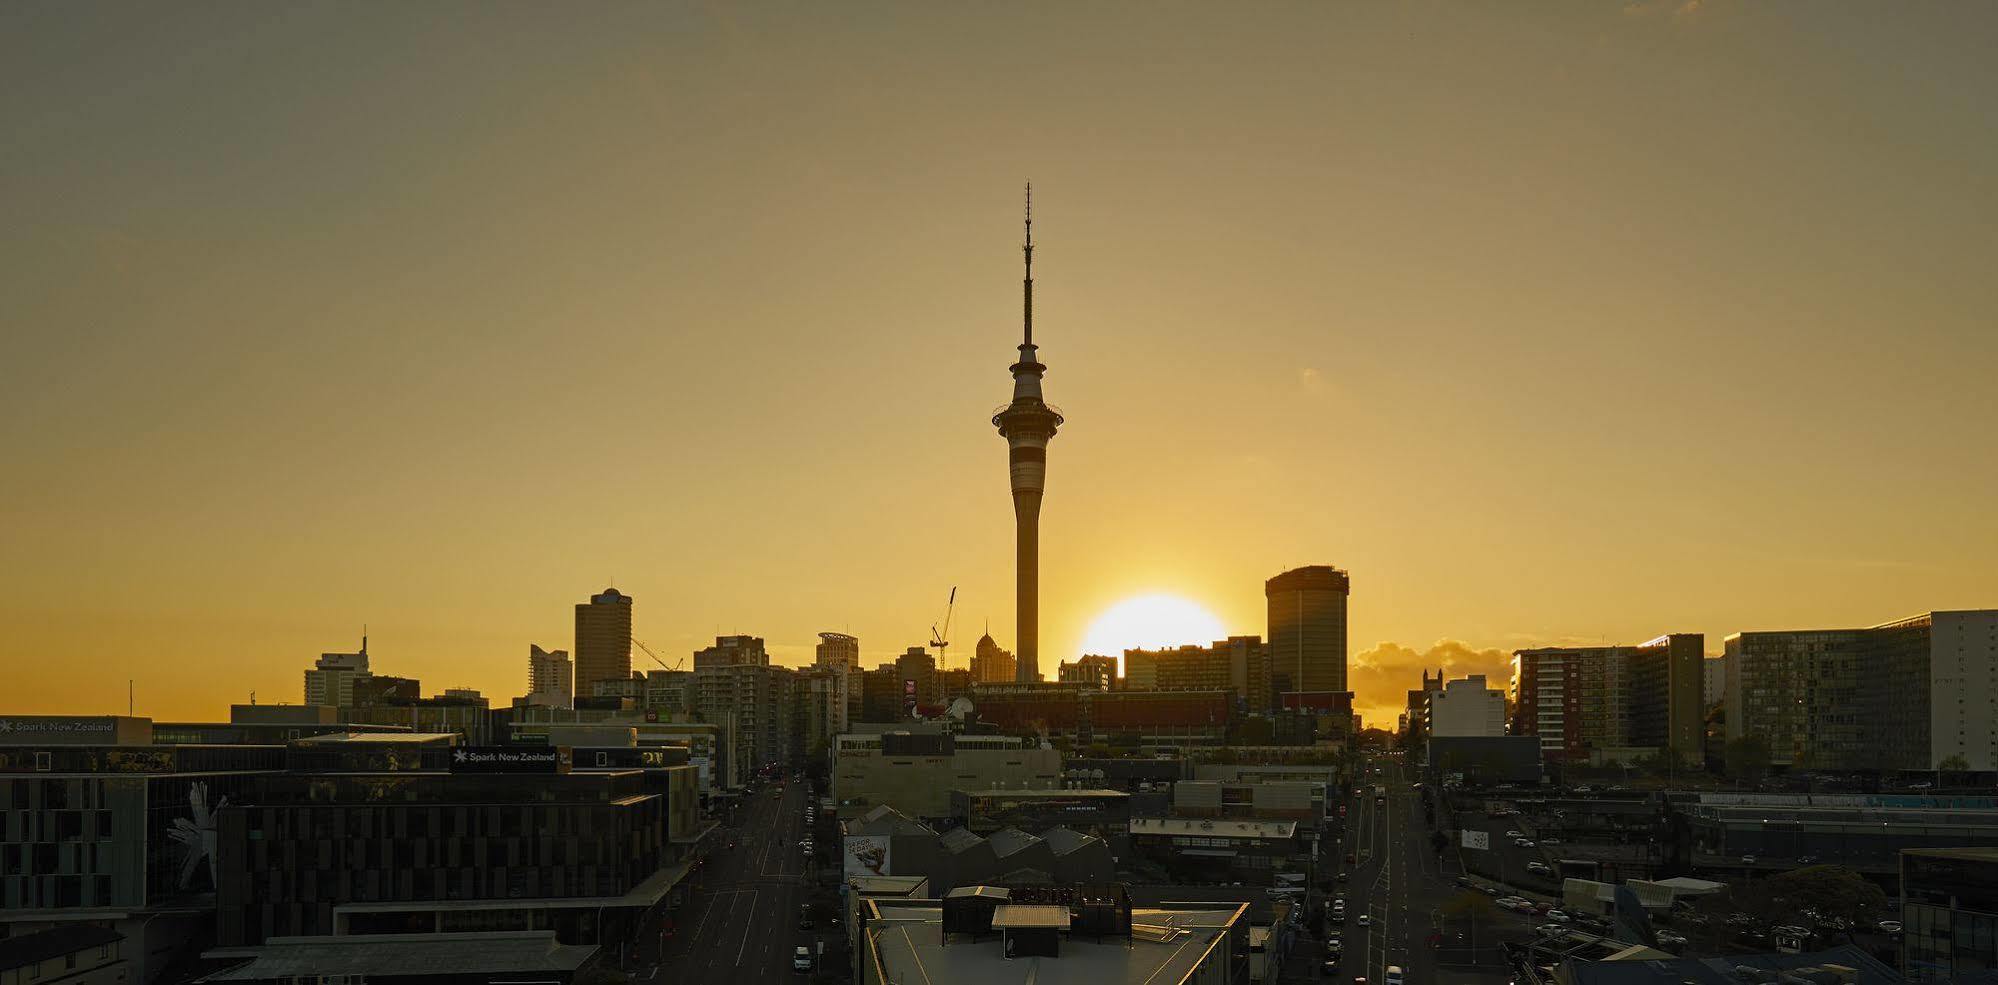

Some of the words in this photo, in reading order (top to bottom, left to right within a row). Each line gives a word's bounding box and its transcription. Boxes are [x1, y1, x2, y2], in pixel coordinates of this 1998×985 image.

[49, 722, 73, 731] New
[74, 722, 114, 731] Zealand
[470, 752, 496, 762] Spark
[498, 752, 519, 761] New
[520, 752, 556, 761] Zealand
